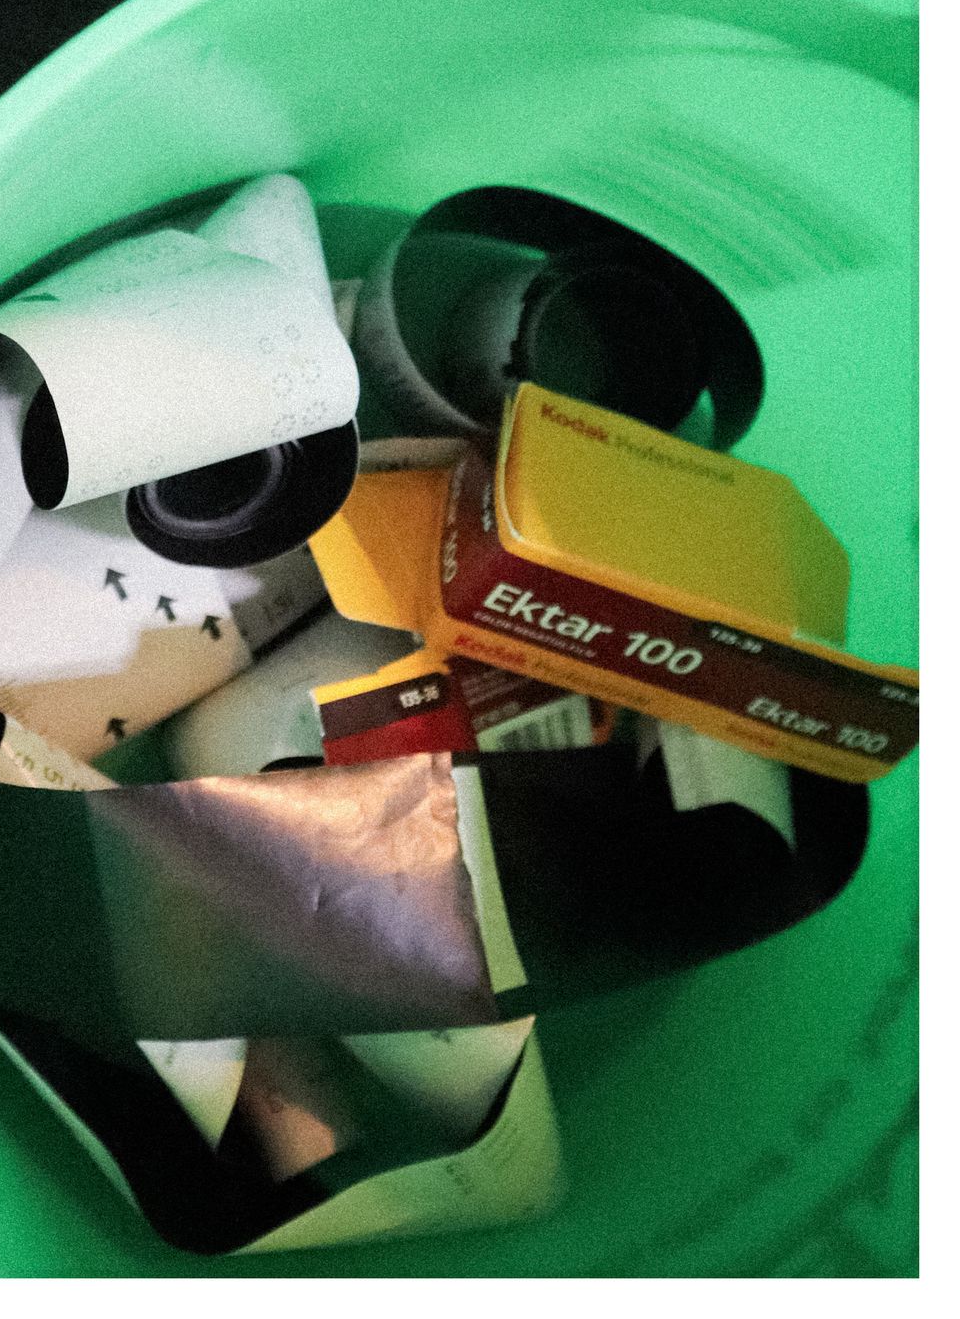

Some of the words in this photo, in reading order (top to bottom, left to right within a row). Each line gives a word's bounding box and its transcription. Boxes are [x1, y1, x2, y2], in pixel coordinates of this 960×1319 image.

[541, 401, 610, 445] Kodak
[453, 633, 528, 669] Kodak
[483, 581, 614, 644] Ektar
[622, 627, 705, 676] 100
[744, 695, 831, 739] Ektar
[837, 724, 889, 757] 100
